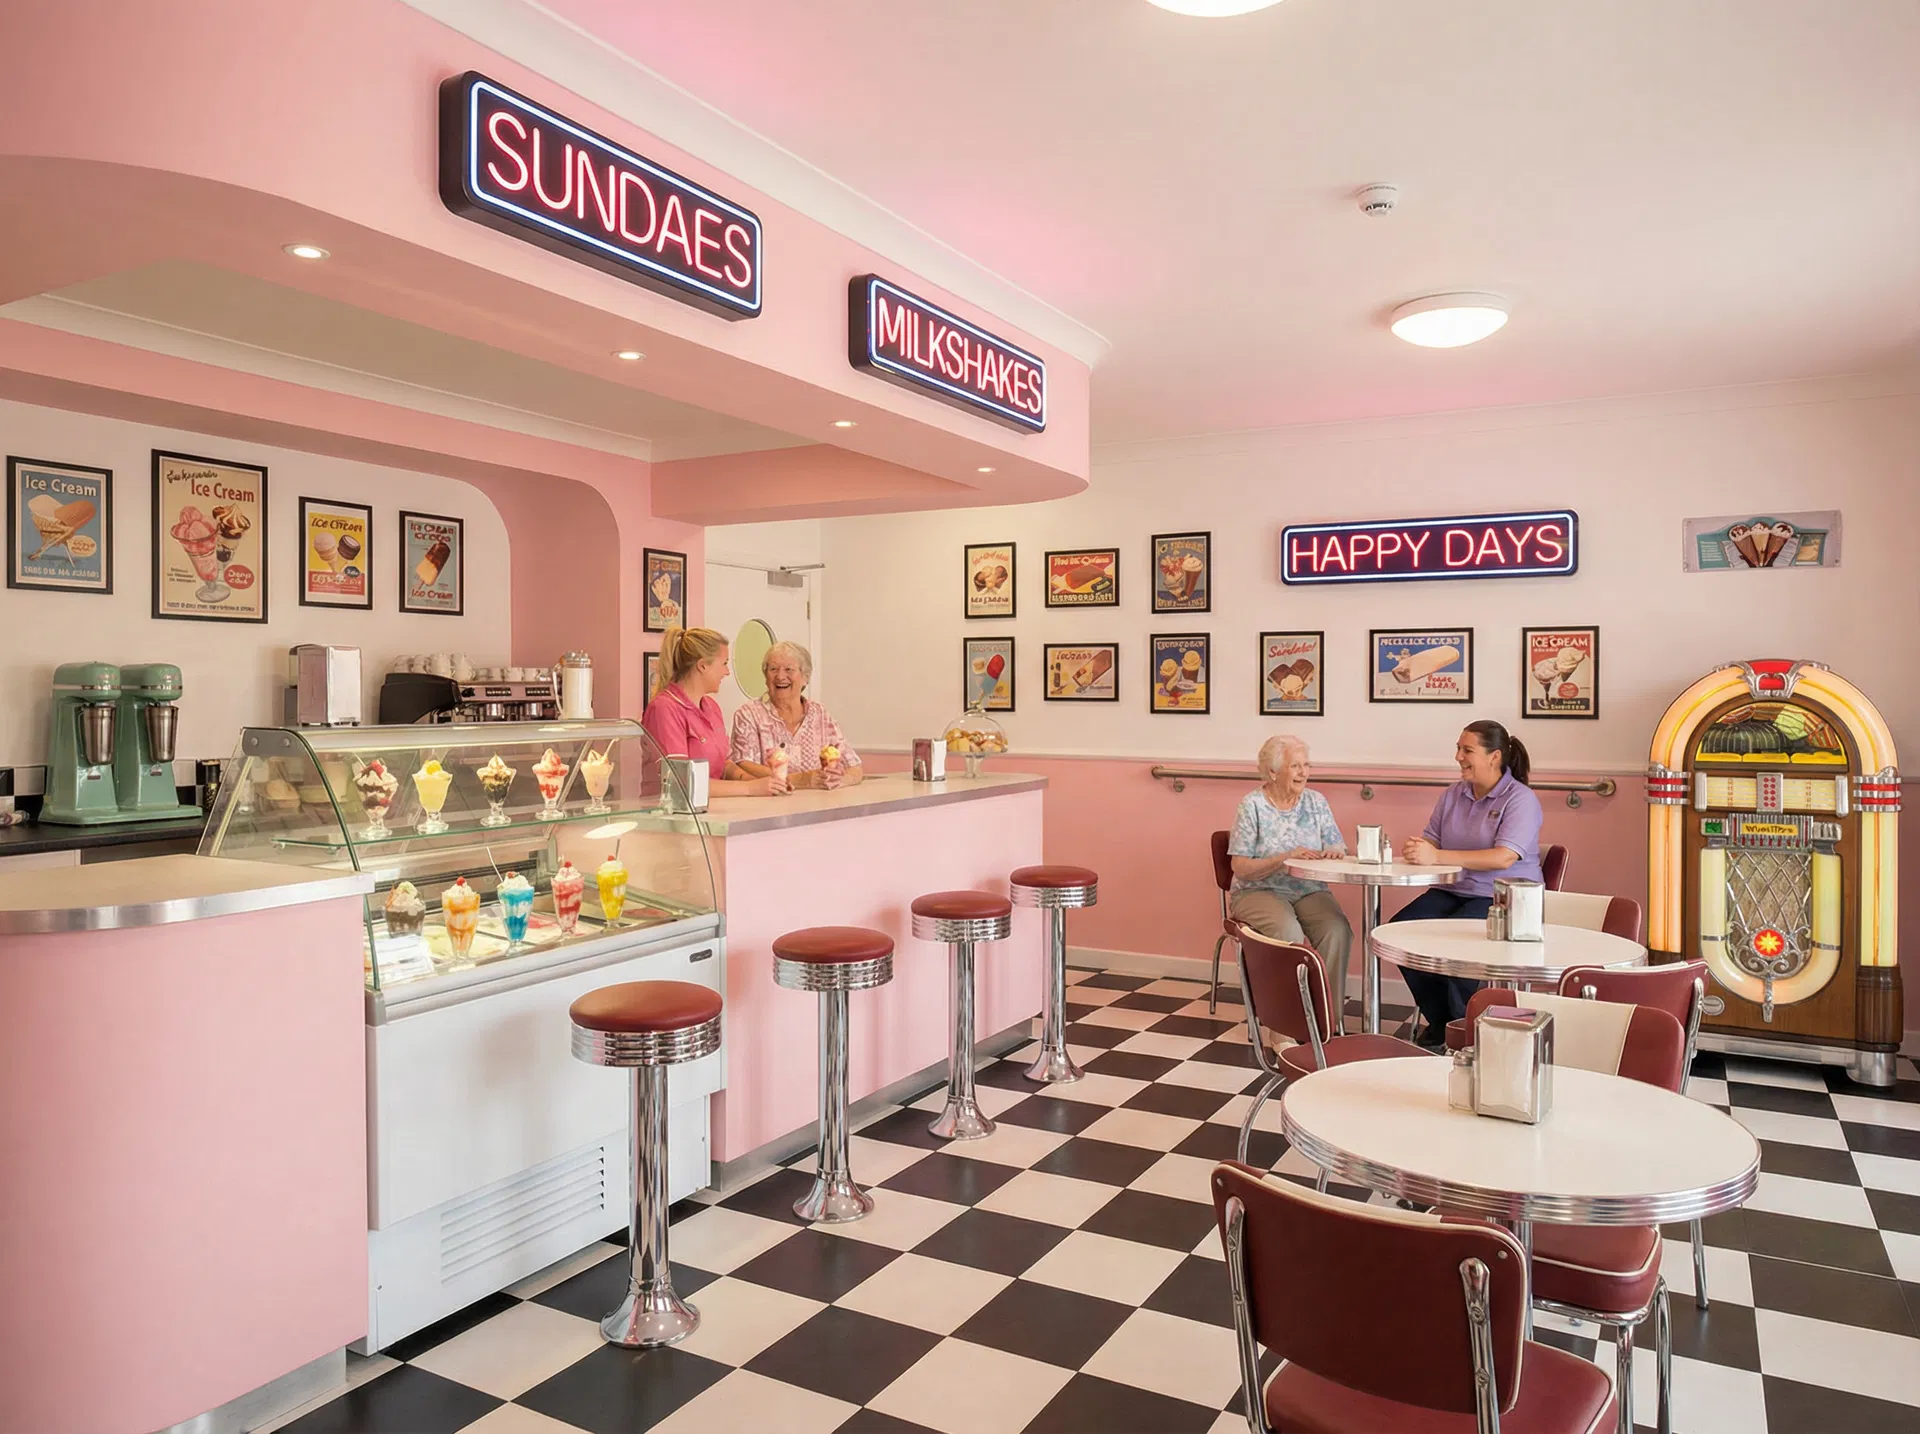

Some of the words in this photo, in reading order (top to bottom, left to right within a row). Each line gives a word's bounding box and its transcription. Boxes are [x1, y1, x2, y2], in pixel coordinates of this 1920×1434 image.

[485, 110, 754, 290] SUNDAES
[877, 296, 1044, 415] MILKSHAKES
[25, 474, 47, 491] Ice
[51, 477, 98, 497] Cream
[191, 479, 210, 497] Ice
[213, 482, 255, 503] Cream
[1291, 530, 1430, 574] HAPPY
[1445, 524, 1564, 567] DAYS
[1532, 636, 1548, 647] ICE
[1550, 636, 1588, 648] CREAM
